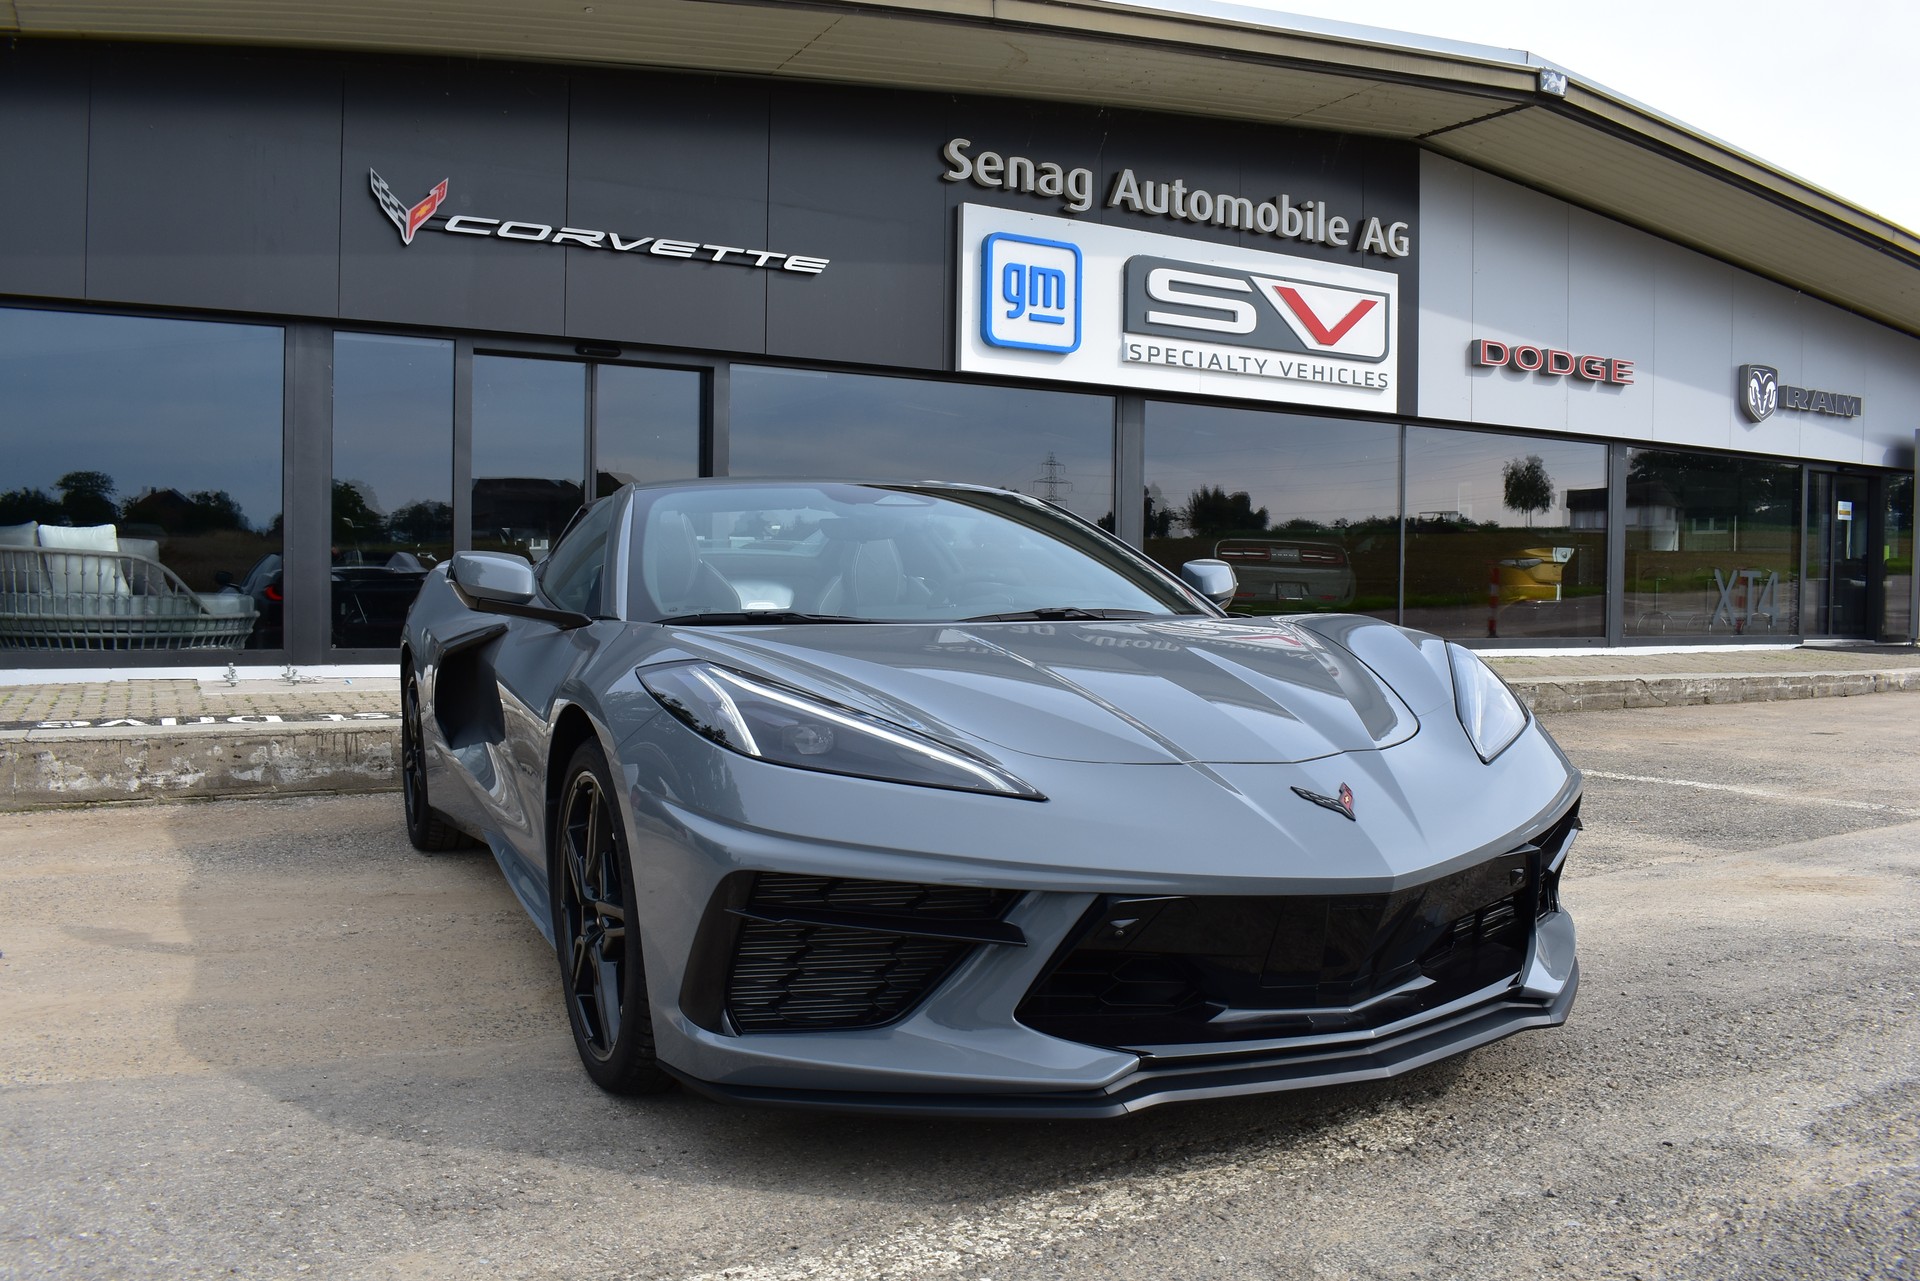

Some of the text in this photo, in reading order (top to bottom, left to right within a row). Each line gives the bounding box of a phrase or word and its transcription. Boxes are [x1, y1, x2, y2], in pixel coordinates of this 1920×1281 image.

[943, 137, 1411, 258] Senag Automobile AG
[444, 215, 830, 274] CORVETTE
[1002, 262, 1067, 325] gm
[1145, 267, 1380, 347] SV
[1128, 343, 1390, 389] SPECIALTY VEHICLES
[1476, 337, 1635, 385] DODGE
[1782, 384, 1862, 418] RAM
[1711, 567, 1781, 627] XT4
